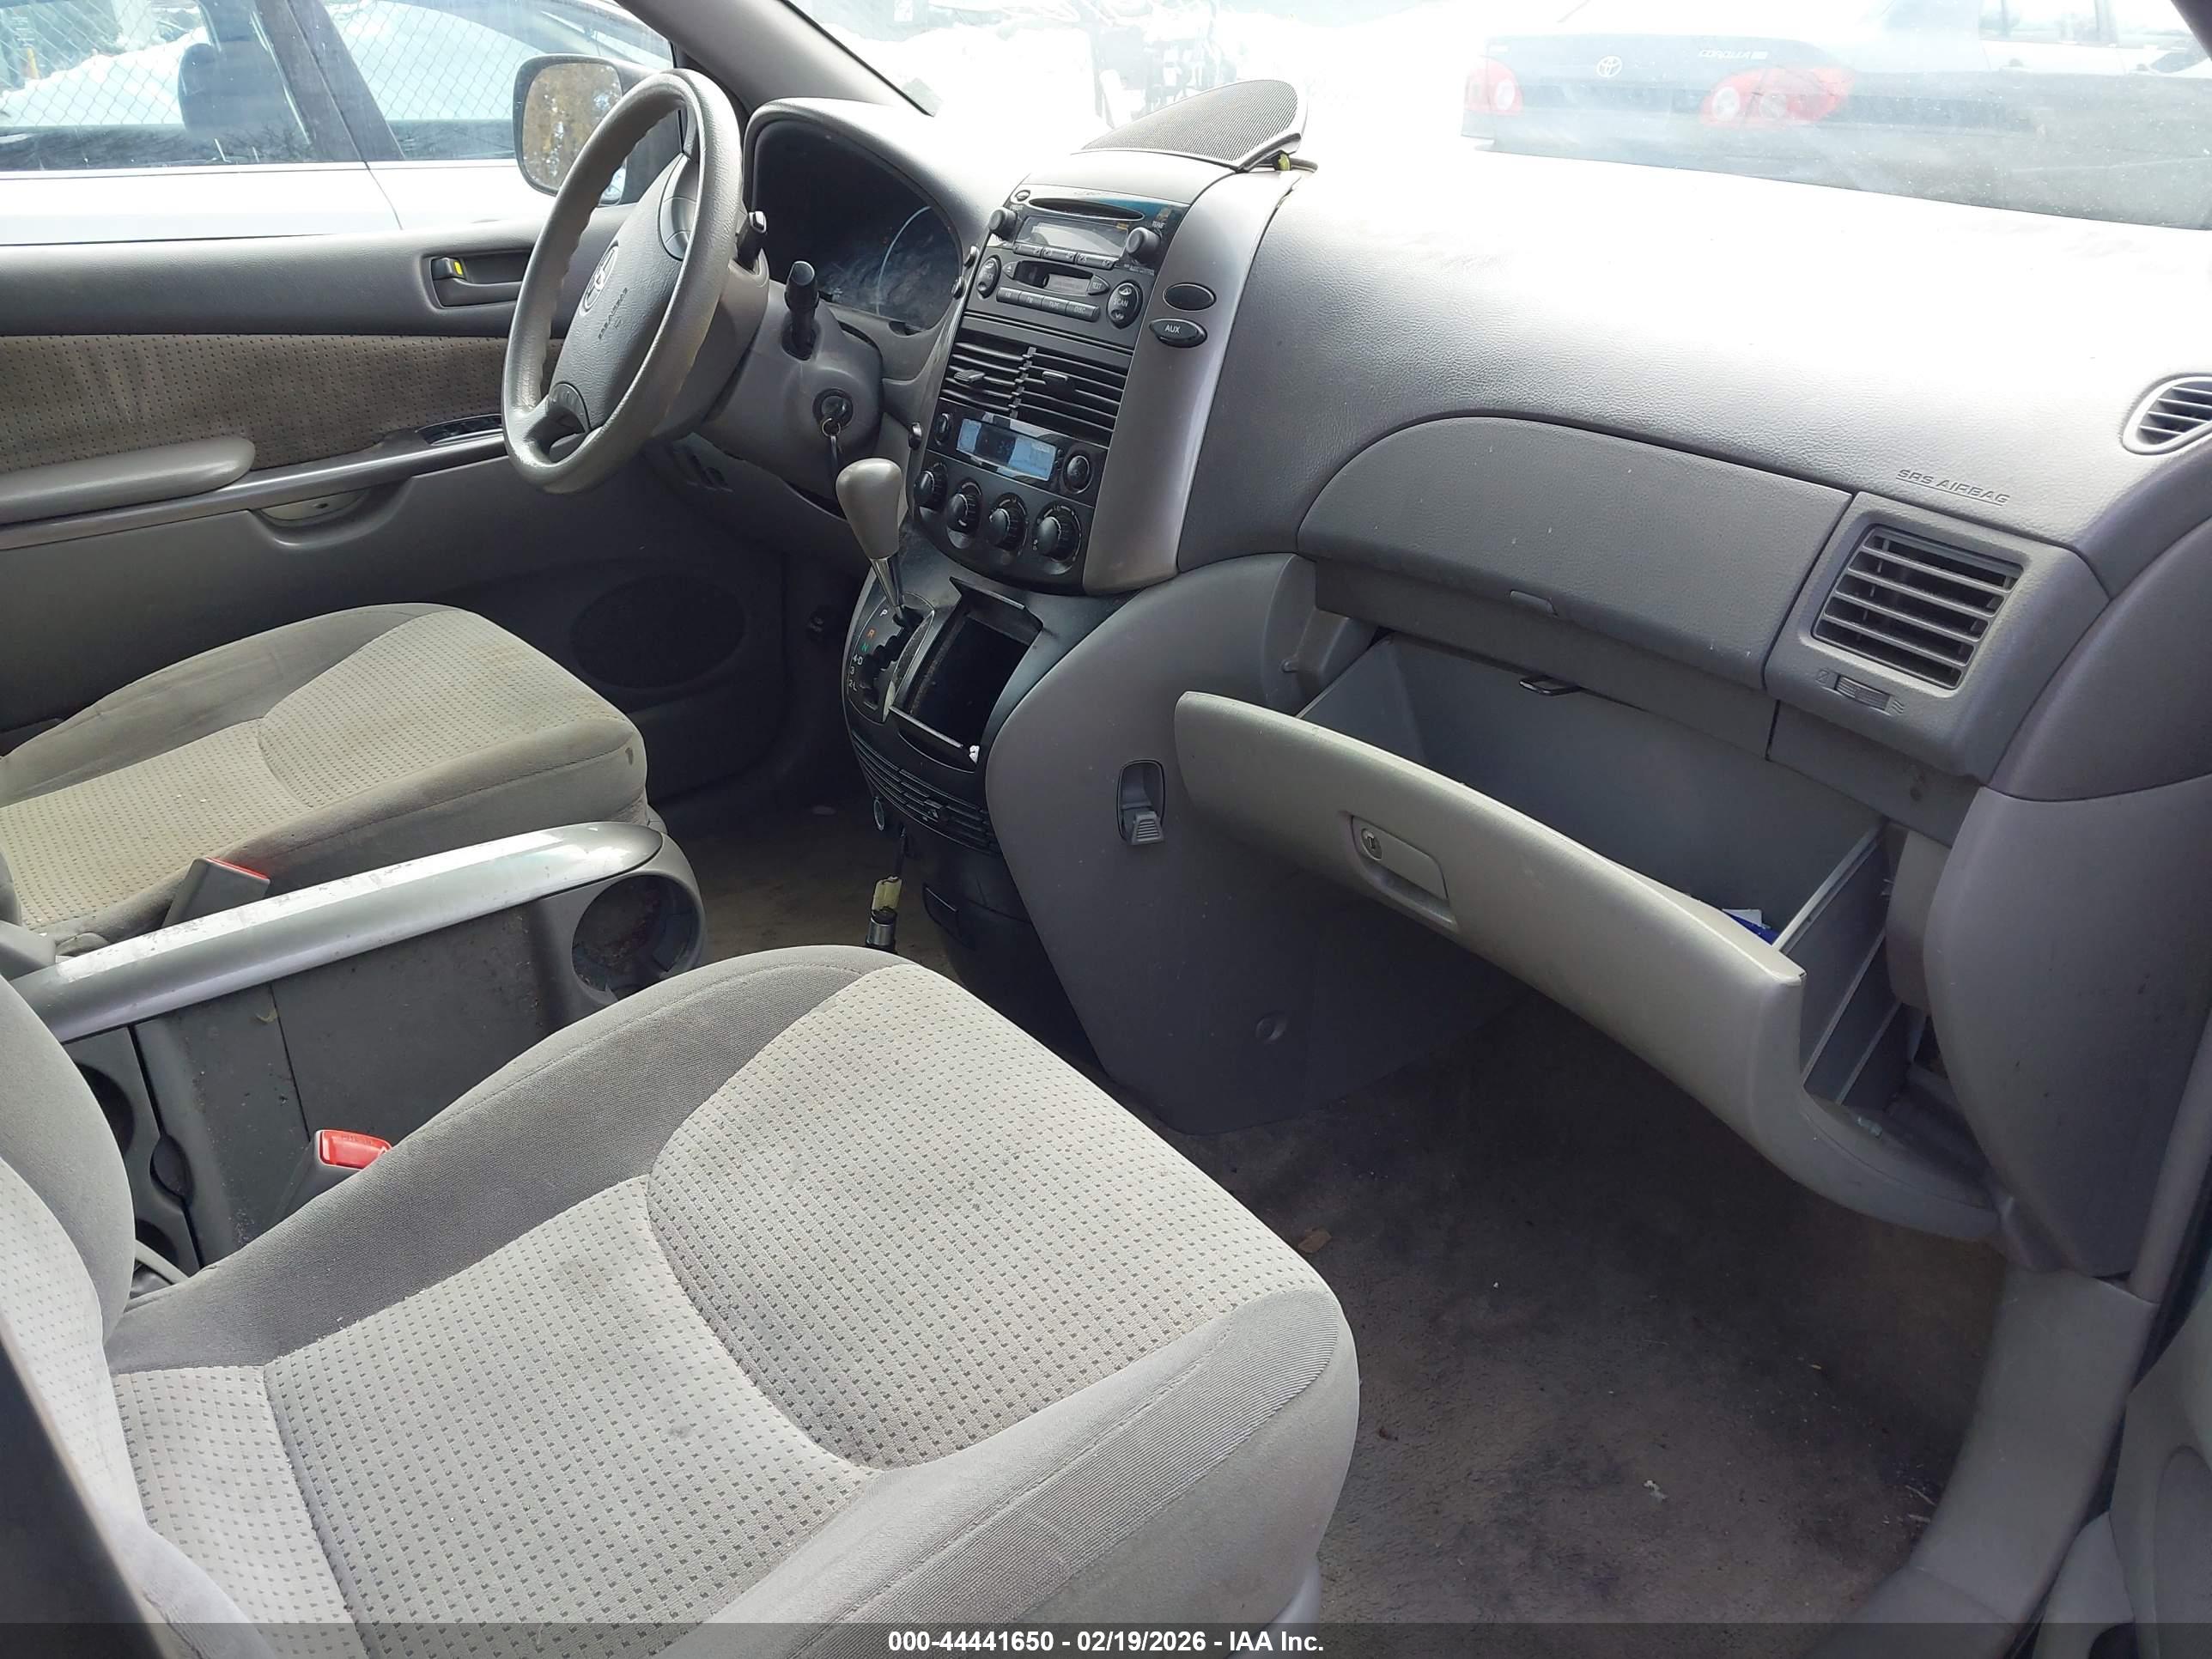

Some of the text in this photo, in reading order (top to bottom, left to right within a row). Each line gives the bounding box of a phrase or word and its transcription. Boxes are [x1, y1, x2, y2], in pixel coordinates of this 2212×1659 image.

[1113, 298, 1128, 307] SCAN
[1165, 325, 1181, 334] AUX
[1897, 469, 2011, 503] SRS AIRBAG
[867, 629, 875, 639] R
[861, 642, 869, 653] N
[850, 666, 854, 675] 3
